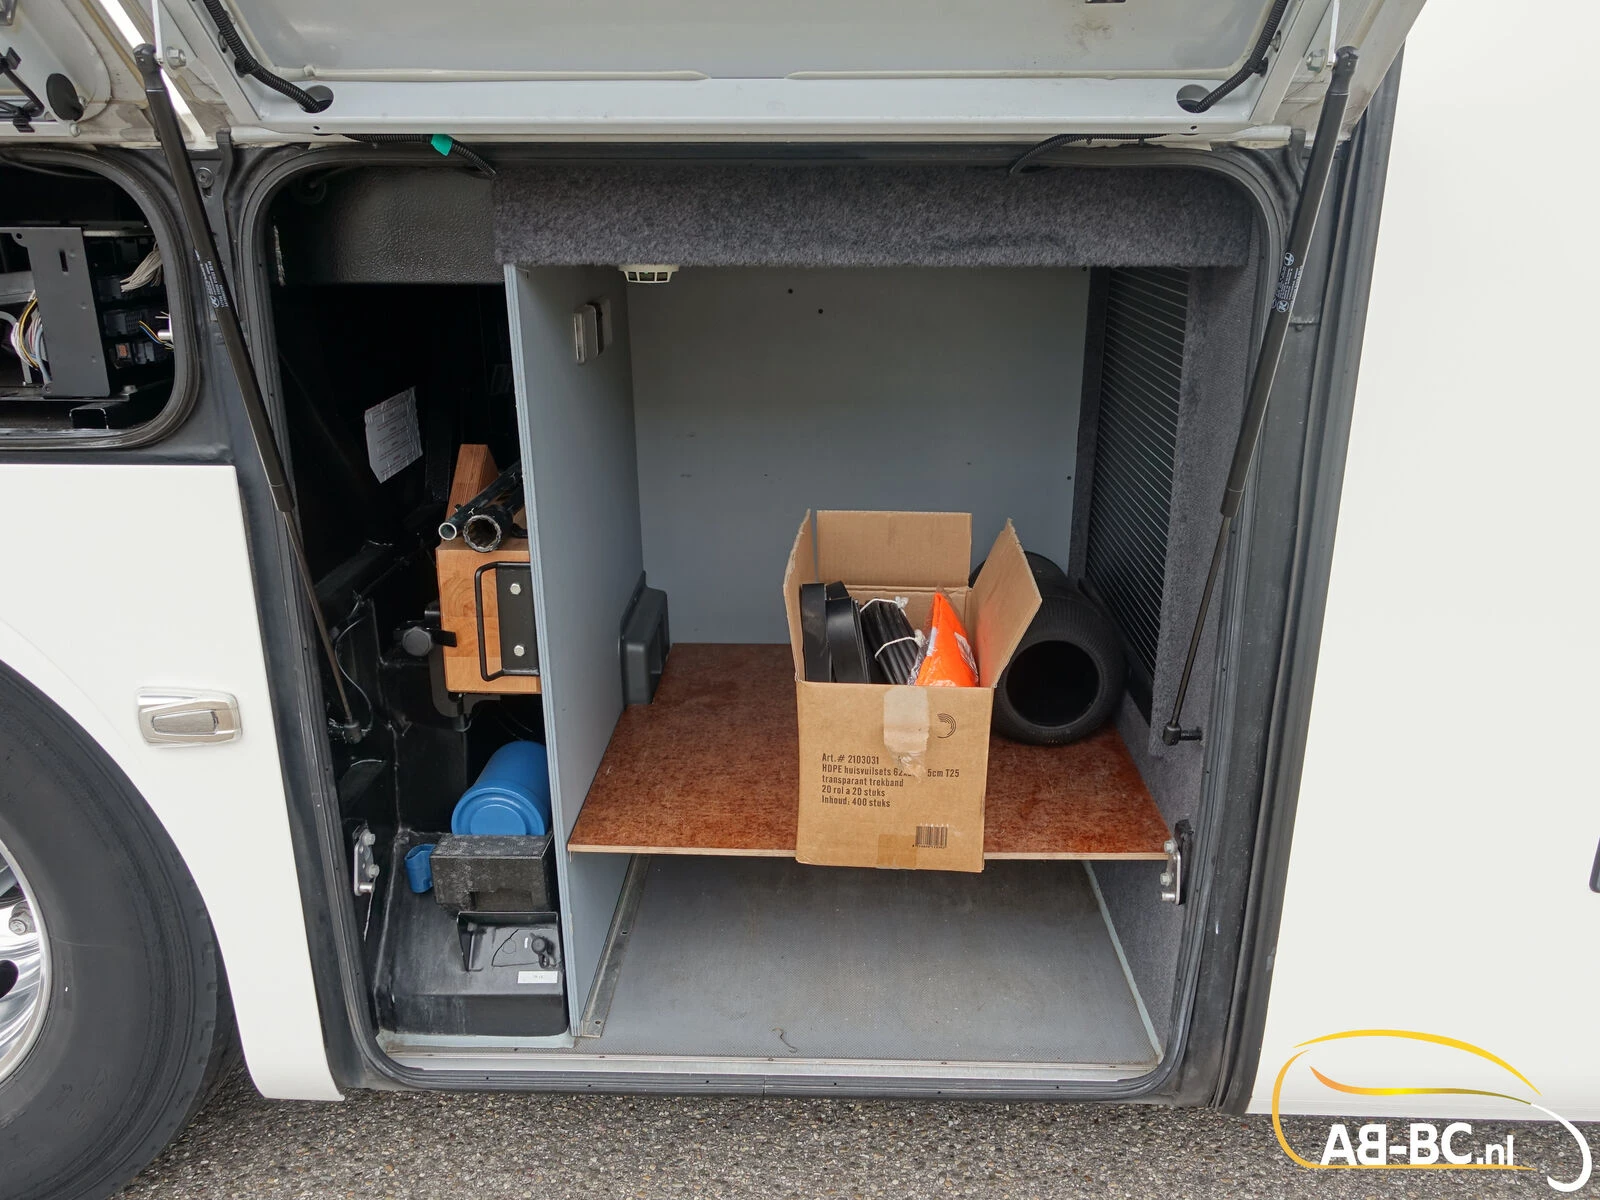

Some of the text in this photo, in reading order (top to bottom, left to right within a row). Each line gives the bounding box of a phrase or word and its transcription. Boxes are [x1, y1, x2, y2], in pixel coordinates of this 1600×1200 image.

[848, 755, 880, 765] 2103031
[822, 764, 842, 774] HDPE
[844, 765, 892, 776] huisvuilsets
[945, 768, 960, 778] T25
[822, 775, 904, 788] transparant trekband
[821, 784, 832, 794] 20
[833, 786, 844, 795] rol
[852, 787, 862, 796] 20
[863, 788, 886, 797] stuks
[851, 798, 867, 806] 400
[868, 799, 891, 808] stuks
